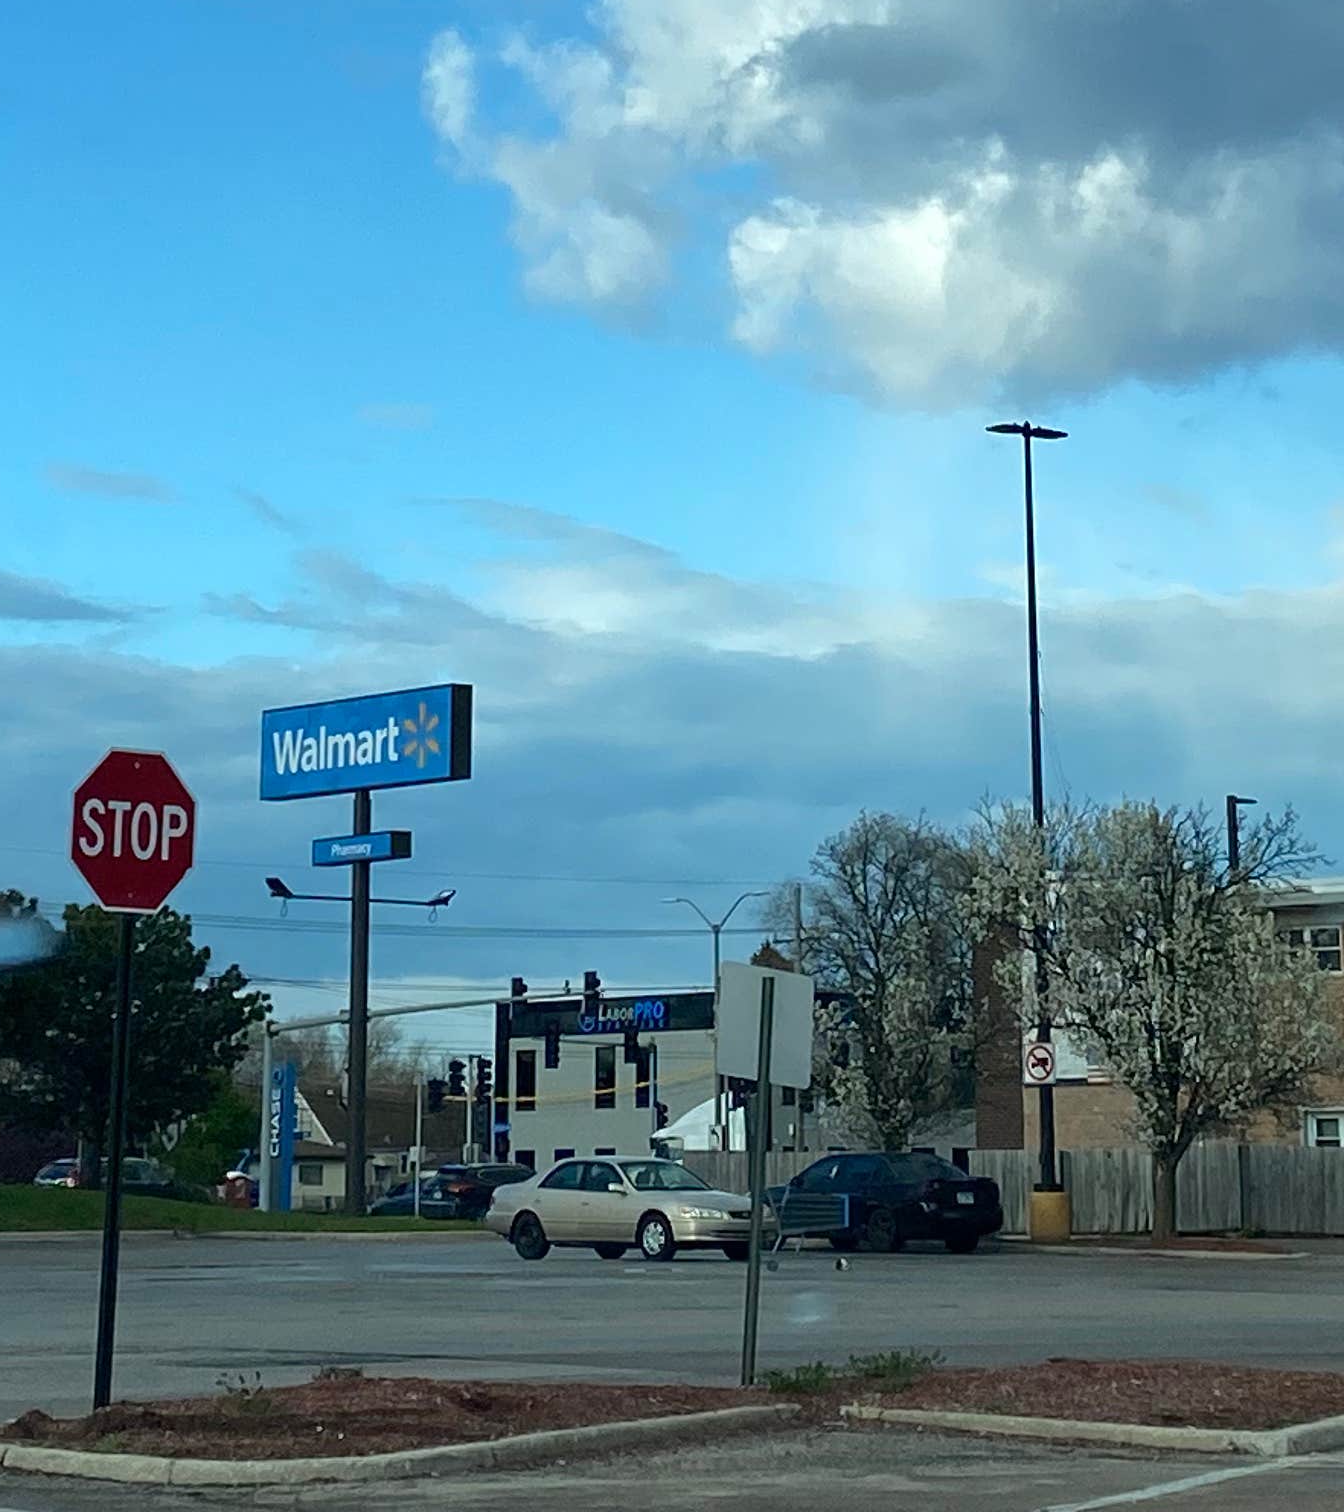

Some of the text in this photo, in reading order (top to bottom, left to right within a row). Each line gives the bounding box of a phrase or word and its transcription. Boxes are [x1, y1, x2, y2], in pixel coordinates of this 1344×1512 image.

[273, 717, 400, 775] Walmart
[79, 798, 188, 861] STOP
[330, 844, 372, 857] Pharmacy
[270, 1088, 281, 1157] CHASE
